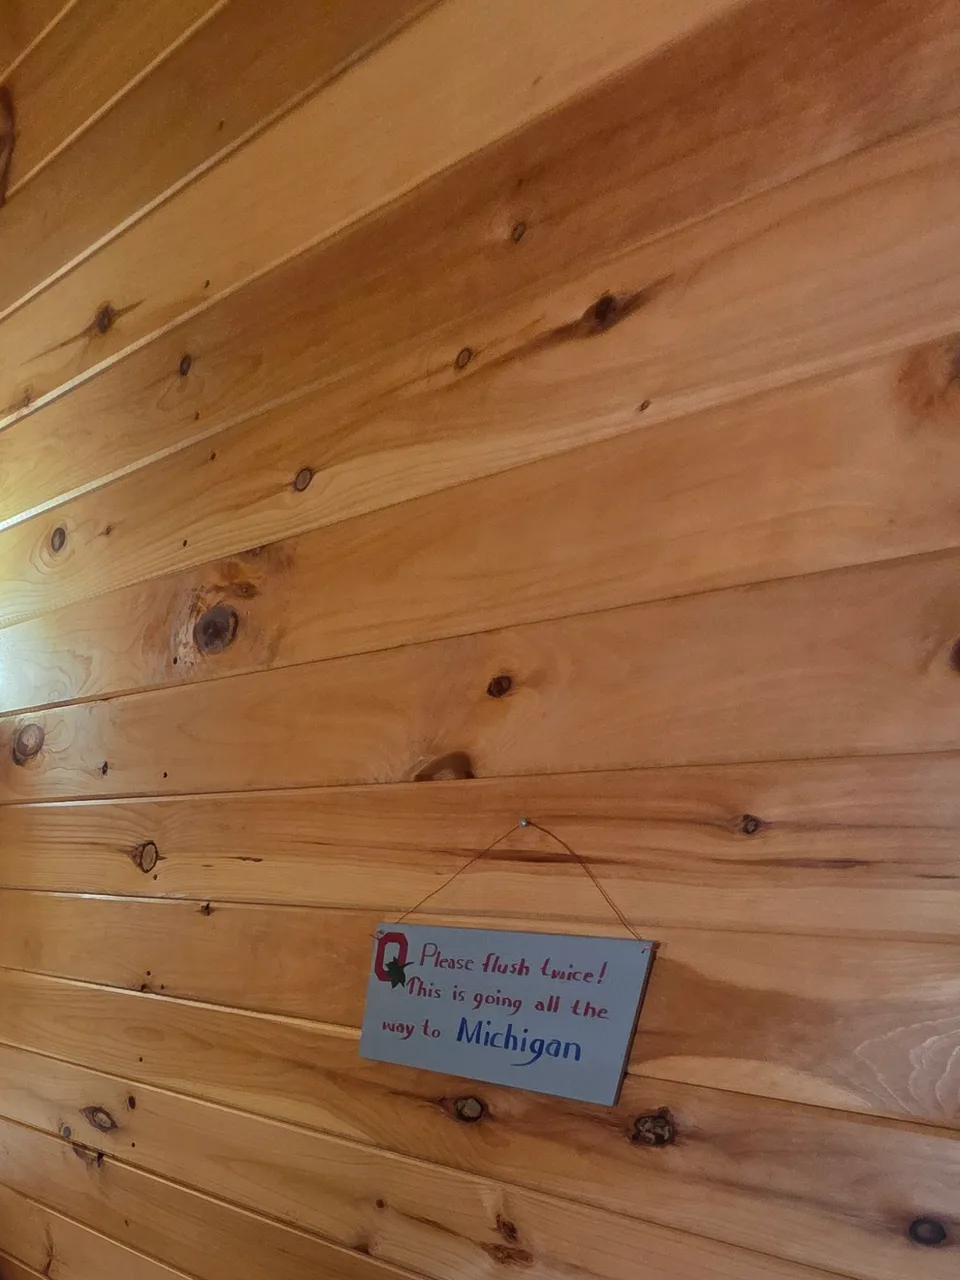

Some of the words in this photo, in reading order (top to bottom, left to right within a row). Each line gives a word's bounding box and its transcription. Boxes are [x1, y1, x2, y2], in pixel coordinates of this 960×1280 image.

[419, 942, 474, 972] Please
[481, 952, 530, 977] flush
[540, 957, 608, 985] twice!
[406, 975, 442, 999] This
[451, 984, 466, 1002] is
[471, 988, 523, 1017] going
[534, 995, 560, 1014] all
[570, 999, 610, 1020] the
[382, 1020, 416, 1041] way
[421, 1018, 442, 1039] to
[456, 1016, 582, 1067] Michigan
